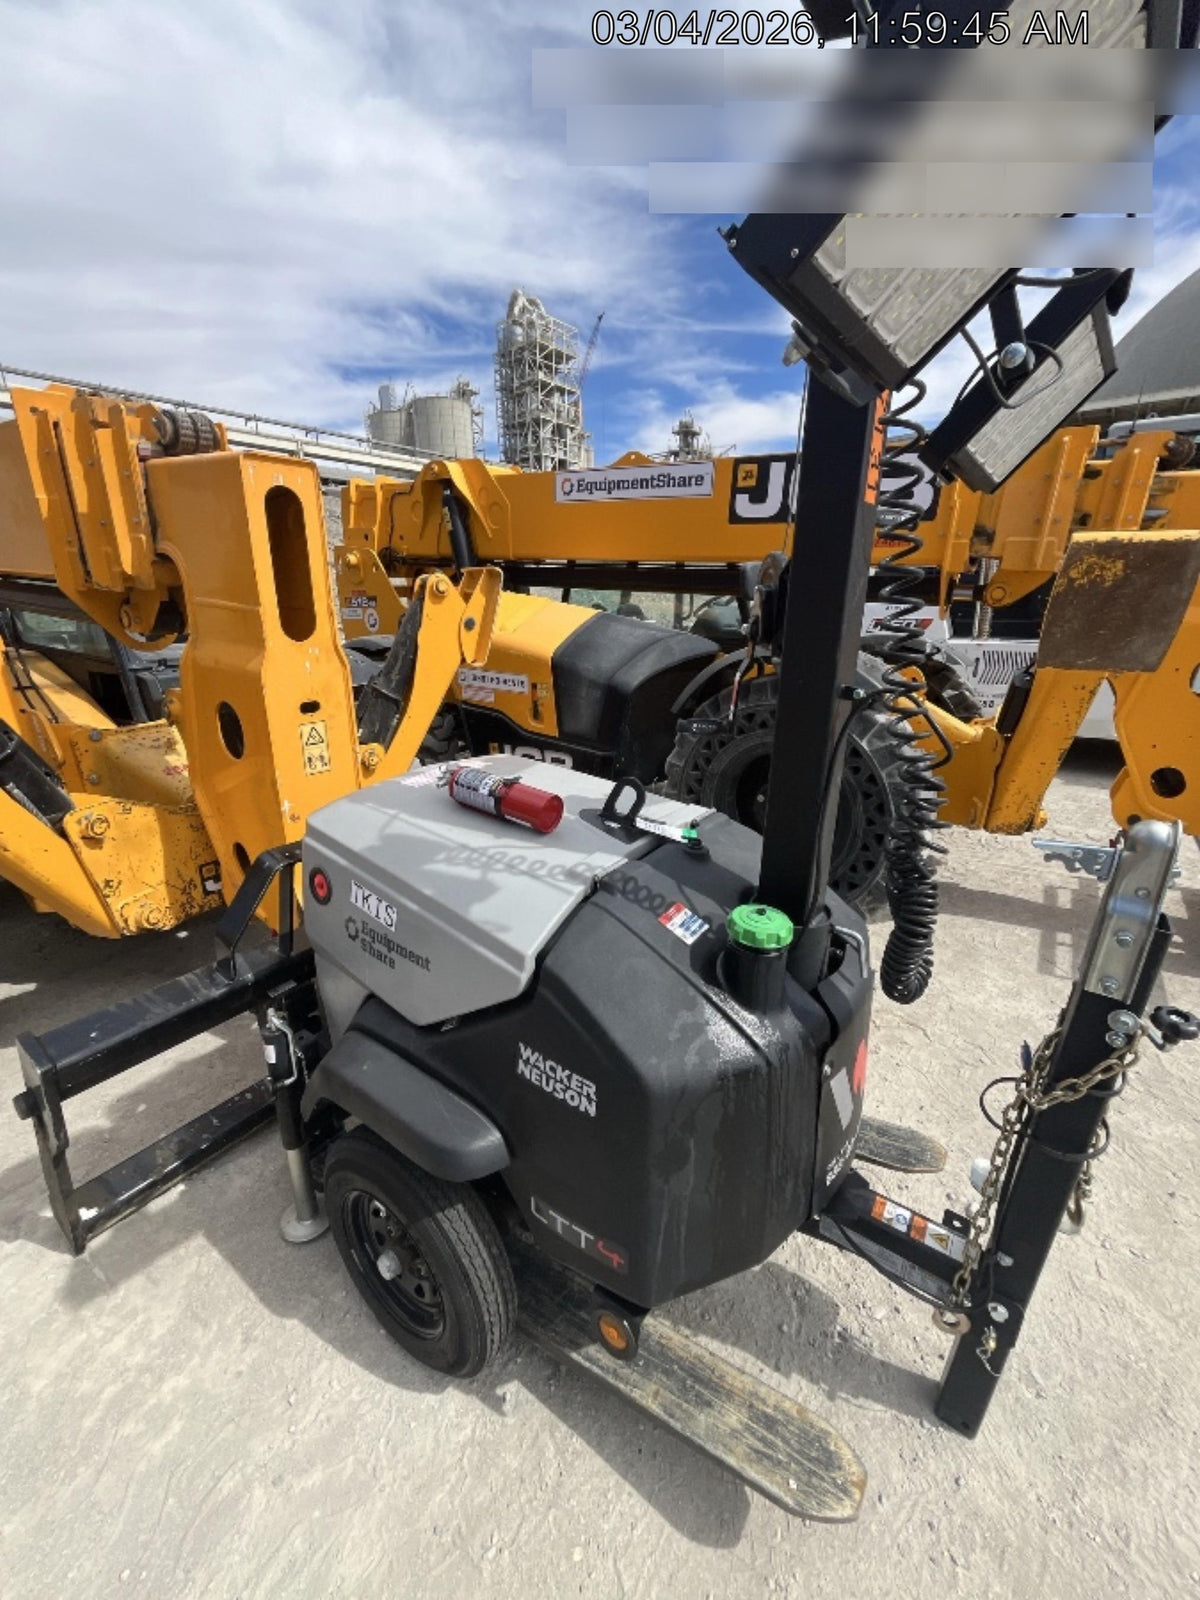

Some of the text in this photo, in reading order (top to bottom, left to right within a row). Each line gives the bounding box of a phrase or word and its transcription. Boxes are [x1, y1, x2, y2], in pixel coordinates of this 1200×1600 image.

[576, 473, 705, 495] EquipmentShare
[735, 453, 934, 518] JB
[361, 920, 431, 972] Equipment
[361, 938, 395, 969] Share
[517, 1058, 597, 1117] NEUSON
[518, 1041, 597, 1101] WACKER
